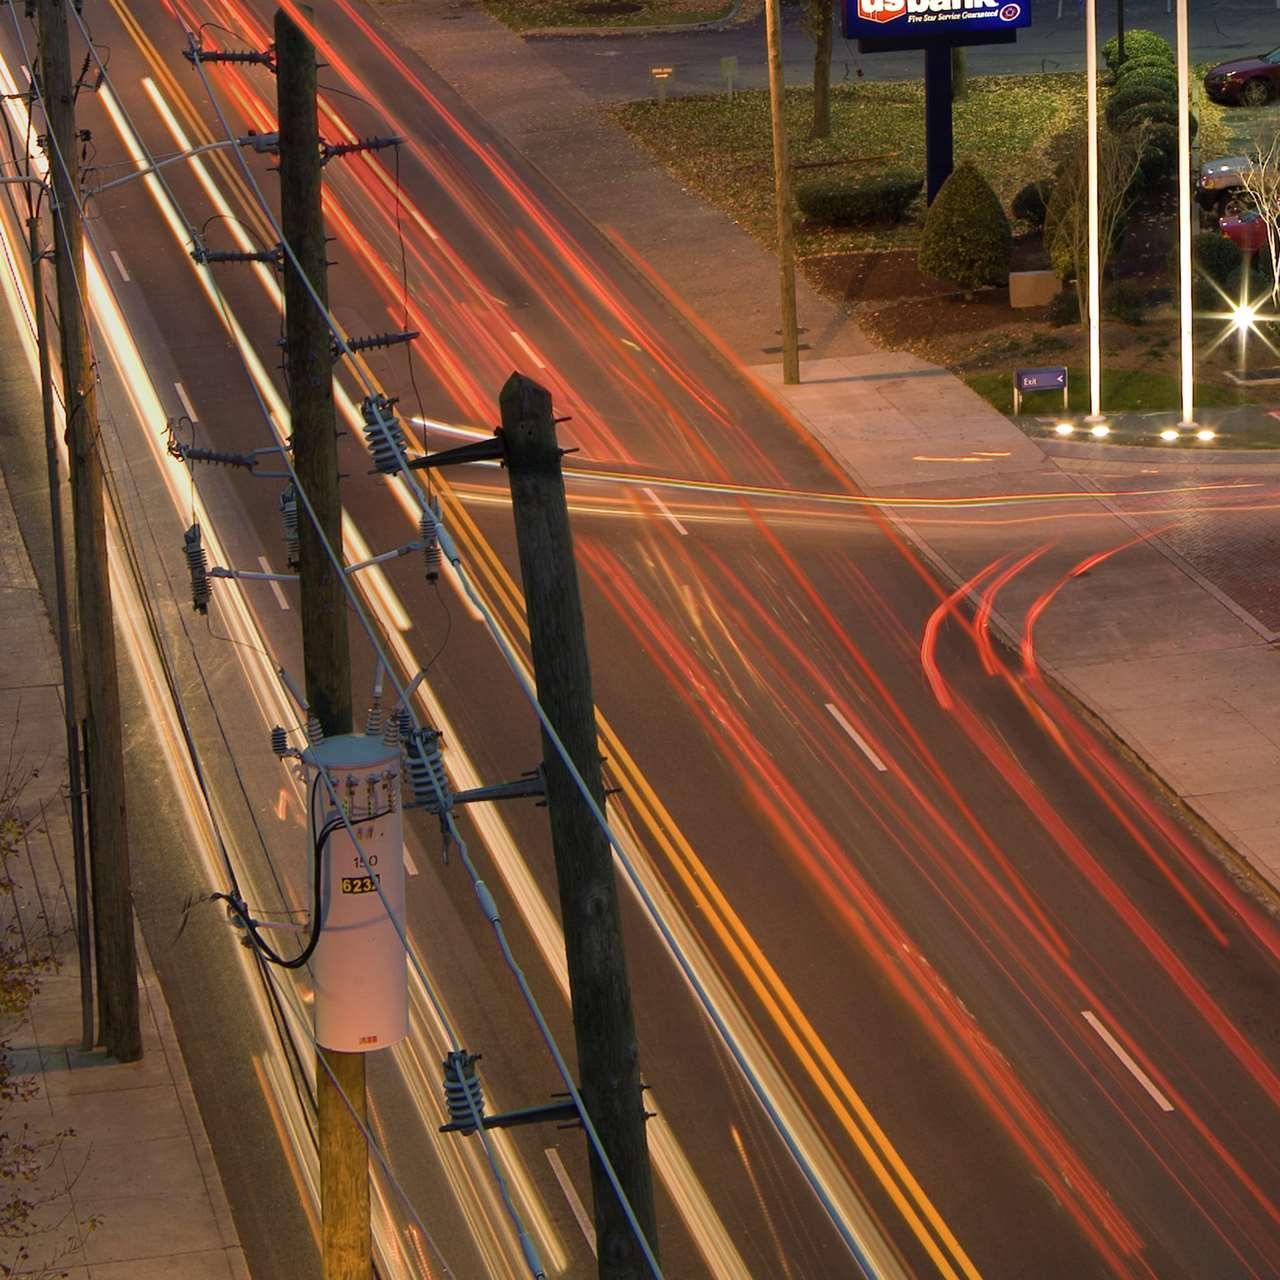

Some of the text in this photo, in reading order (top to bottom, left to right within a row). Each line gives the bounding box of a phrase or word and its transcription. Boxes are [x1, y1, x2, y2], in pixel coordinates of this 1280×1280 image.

[908, 10, 998, 23] Five Star Service Guaranteed
[1023, 377, 1037, 386] Exit
[343, 876, 379, 893] 623
